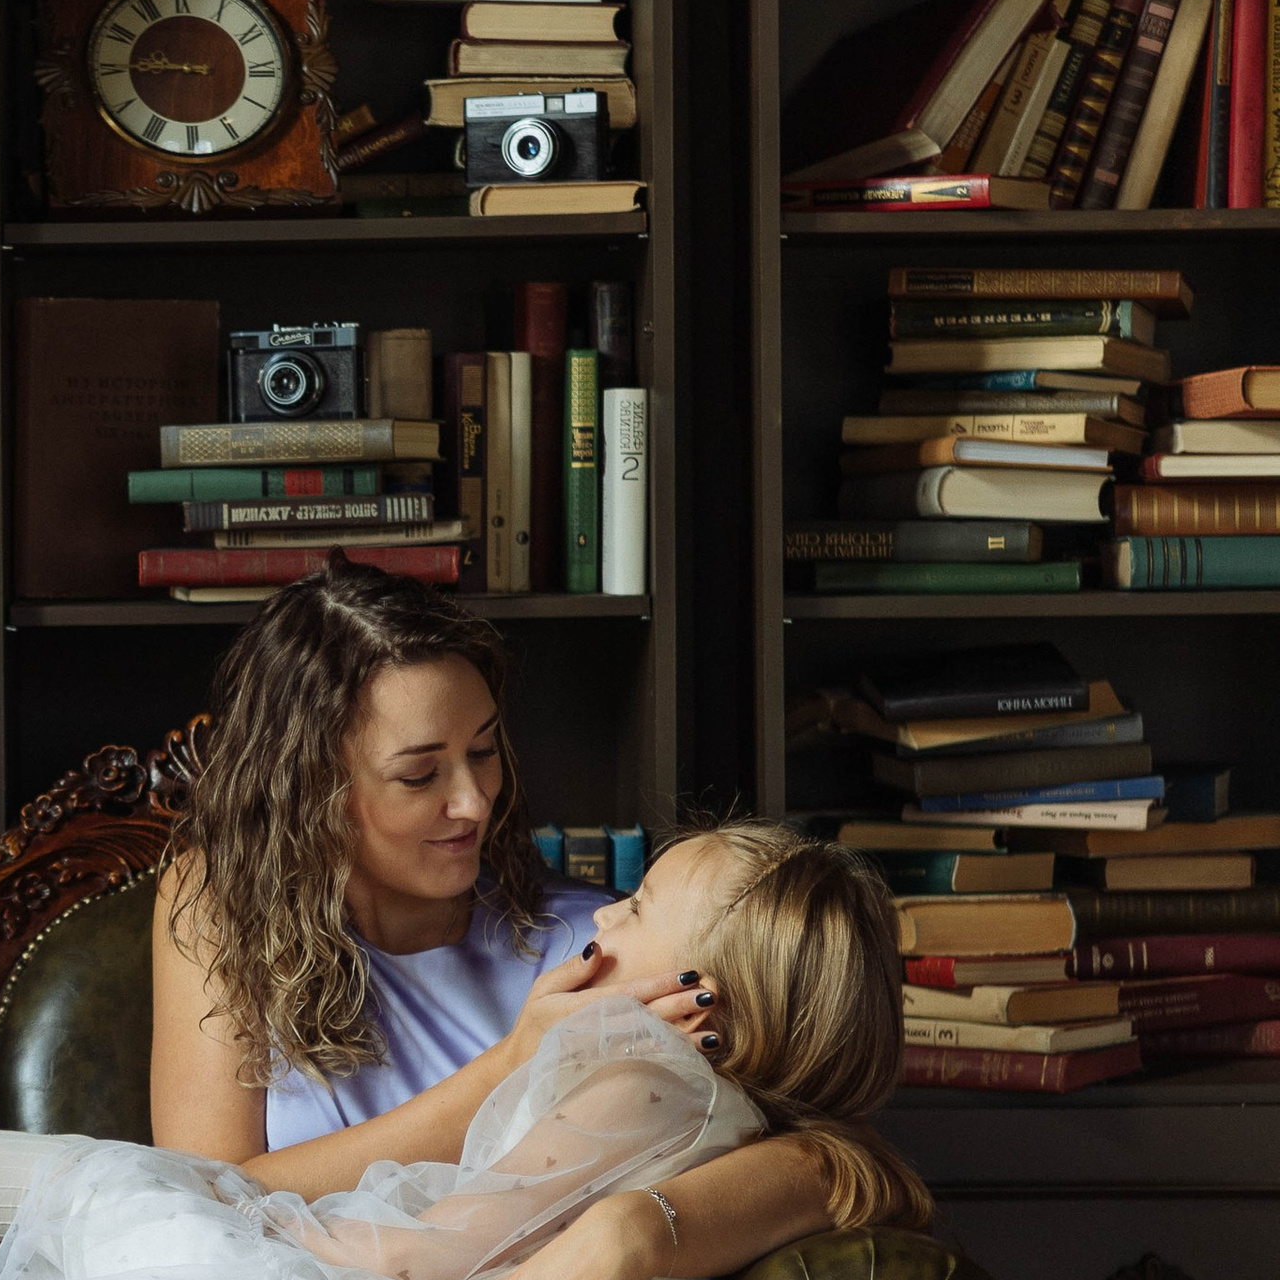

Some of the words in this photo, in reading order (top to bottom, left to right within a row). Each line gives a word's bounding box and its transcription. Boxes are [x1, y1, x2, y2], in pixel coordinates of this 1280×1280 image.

[247, 60, 275, 79] XII
[861, 188, 904, 199] АЛЕКСАНДР
[956, 185, 967, 195] 2
[269, 333, 302, 345] Смена
[303, 333, 311, 344] 8
[619, 400, 630, 449] ЮЛИУС
[632, 400, 644, 449] ФУЧИК
[459, 412, 474, 471] Кожевников
[467, 422, 482, 456] Вадим
[621, 455, 638, 480] 2
[229, 503, 291, 524] ДЖУНГЛИ
[295, 502, 342, 521] СИНКЛЕР
[343, 502, 378, 519] ЭПТОН
[784, 533, 820, 545] США
[824, 530, 894, 545] ИСТОРИЯ
[783, 544, 893, 558] ЛИТЕРАТУРНАЯ
[996, 697, 1032, 712] ЮННА
[1032, 695, 1073, 710] МОРИЦ
